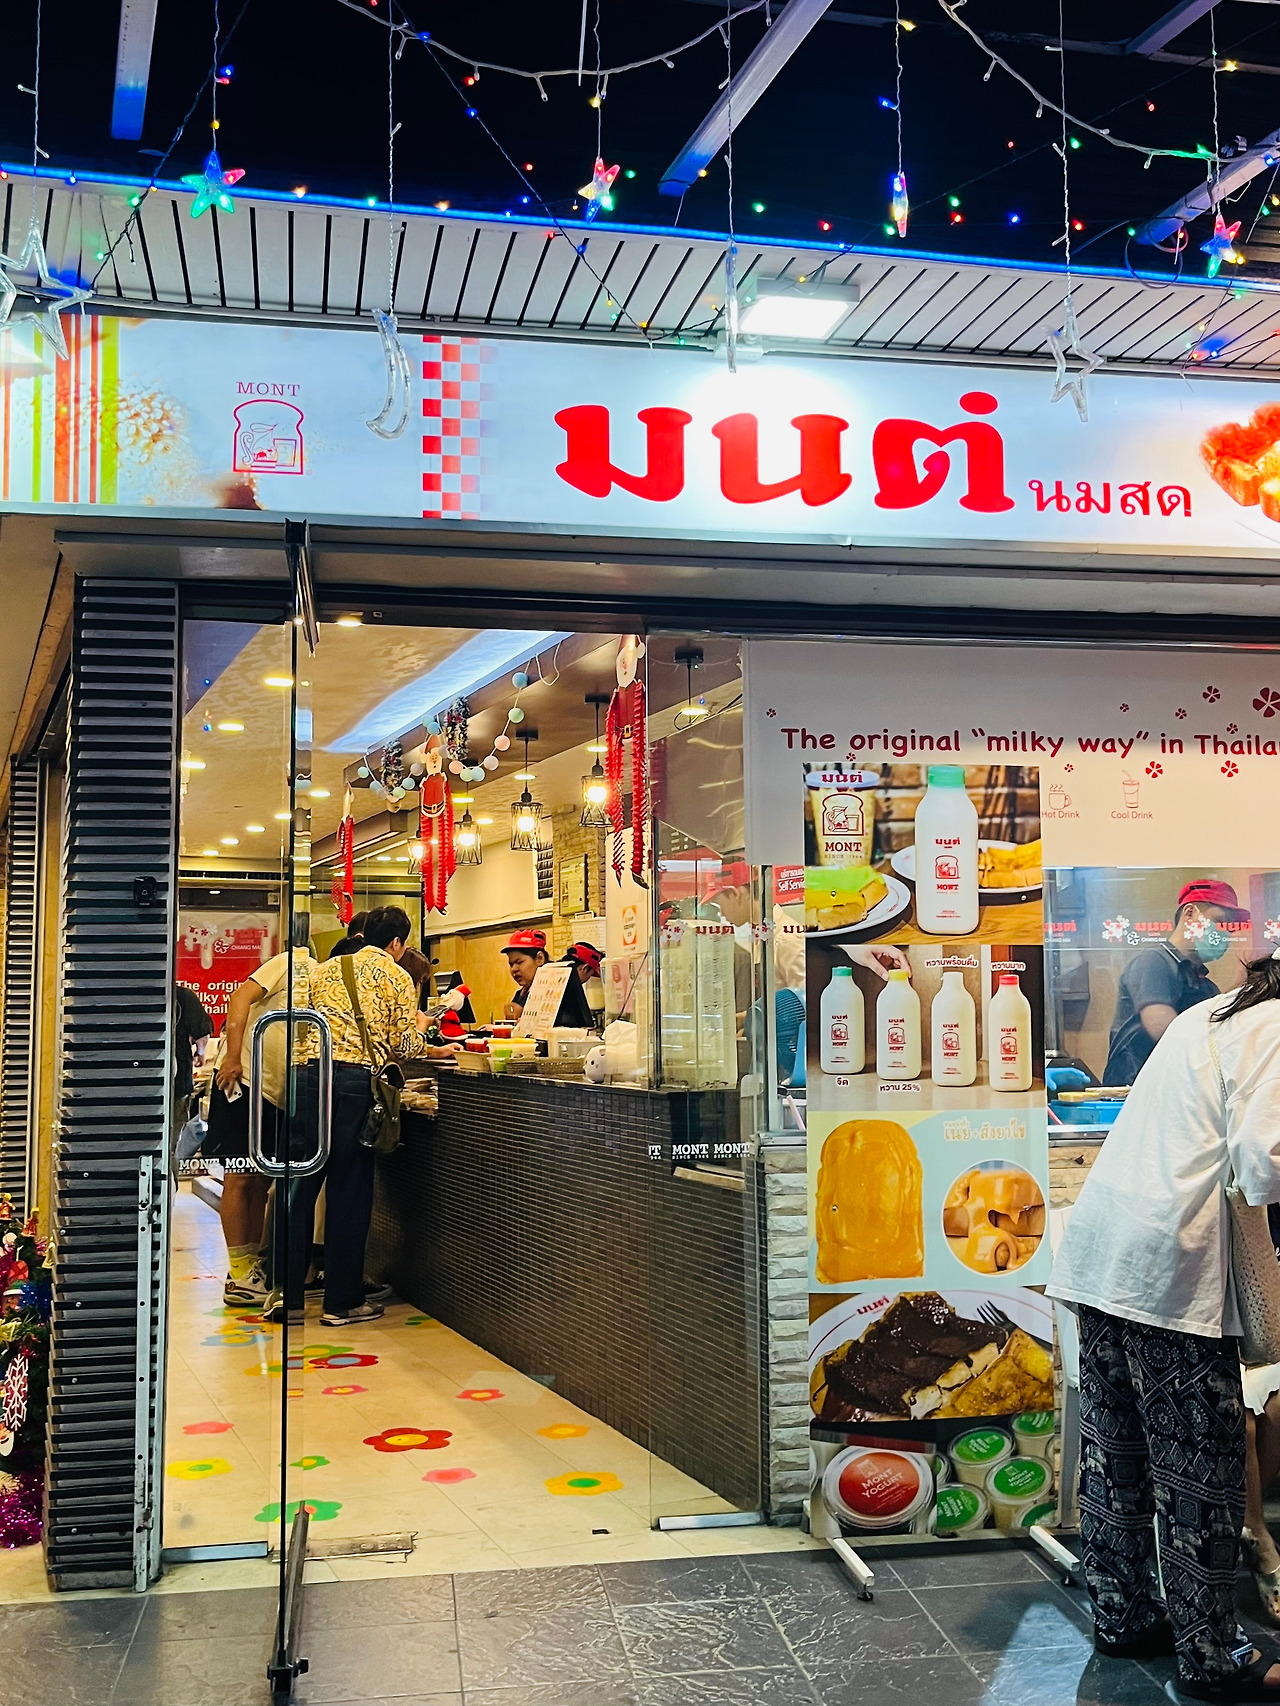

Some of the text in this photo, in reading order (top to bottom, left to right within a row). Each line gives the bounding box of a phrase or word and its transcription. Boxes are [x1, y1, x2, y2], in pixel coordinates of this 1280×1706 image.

[236, 381, 300, 397] MONT
[1028, 479, 1192, 518] นมสด
[780, 727, 836, 750] The
[849, 728, 961, 758] original
[1160, 732, 1184, 754] in
[1193, 734, 1280, 756] Thaila
[1041, 810, 1081, 819] Hot Drink
[1111, 810, 1154, 819] Cool Drink
[825, 841, 862, 852] MONT
[778, 880, 789, 892] Self
[176, 980, 200, 990] The
[902, 1083, 921, 1091] 25%
[672, 1142, 751, 1155] MONT MONT
[225, 1157, 255, 1169] MON
[861, 1468, 893, 1489] MONT
[862, 1472, 904, 1498] YOGURT
